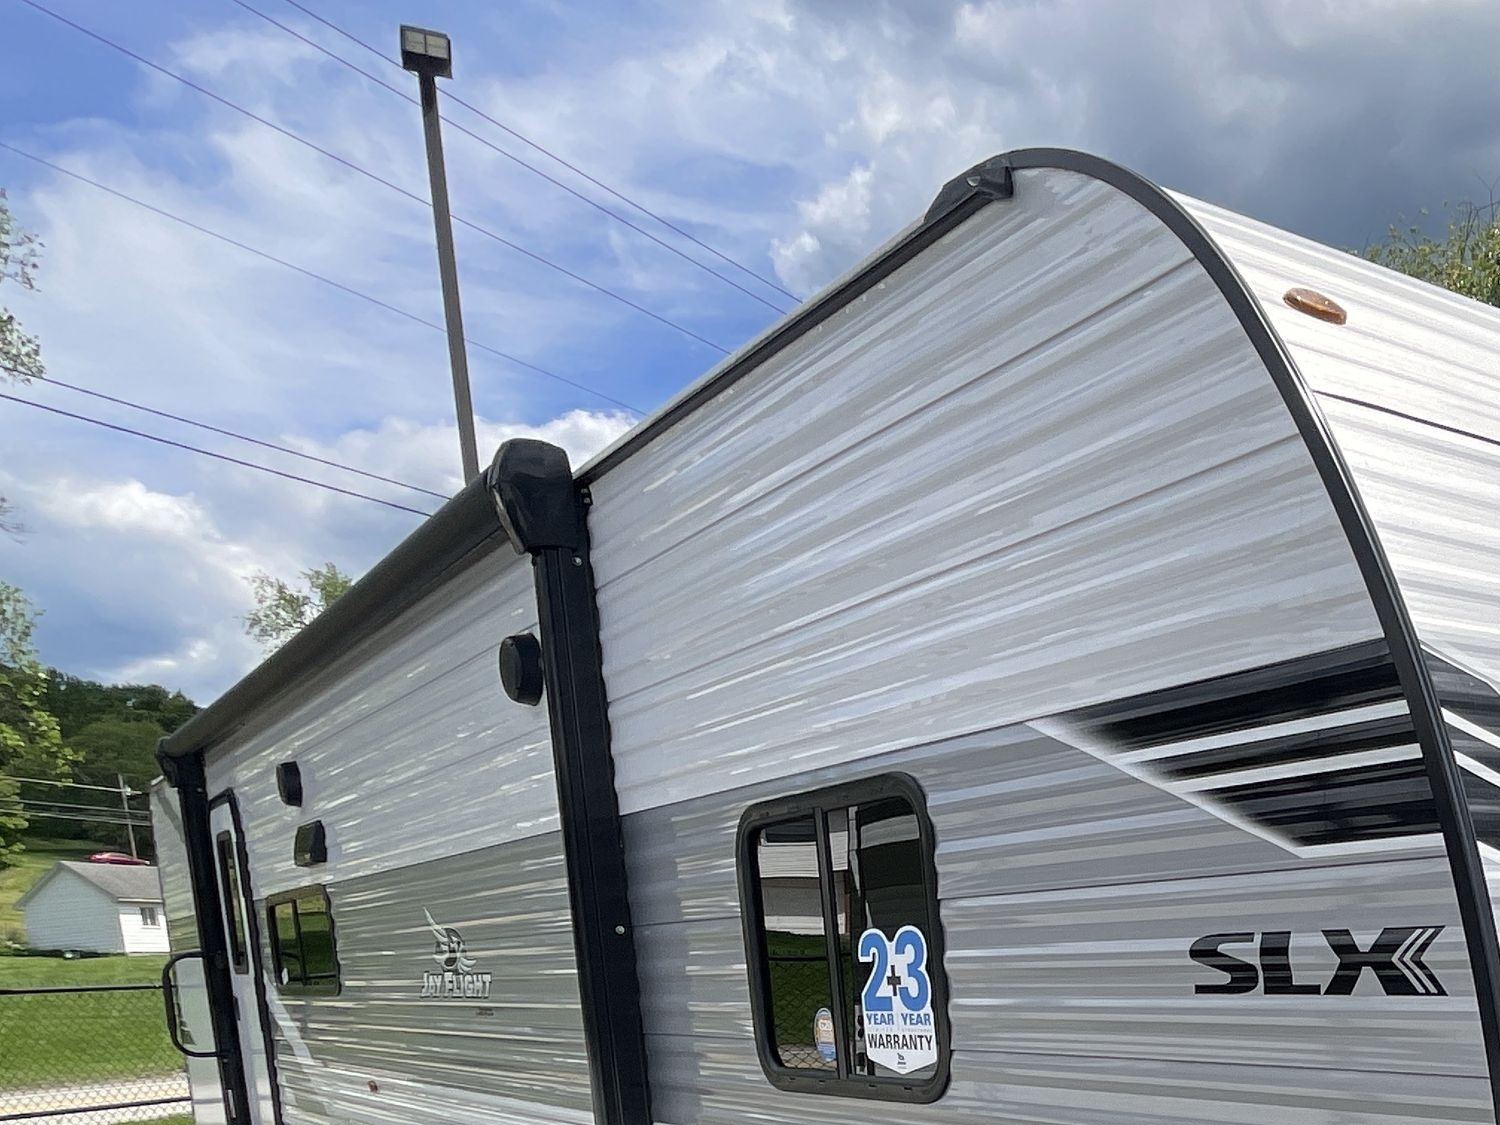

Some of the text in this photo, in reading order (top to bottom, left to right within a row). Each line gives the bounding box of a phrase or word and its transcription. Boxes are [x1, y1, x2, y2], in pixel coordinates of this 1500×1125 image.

[1188, 925, 1449, 996] SLX
[420, 969, 492, 999] JAY FLIGHT
[866, 1013, 932, 1026] YEAR YEAR
[867, 1033, 933, 1051] WARRANTY
